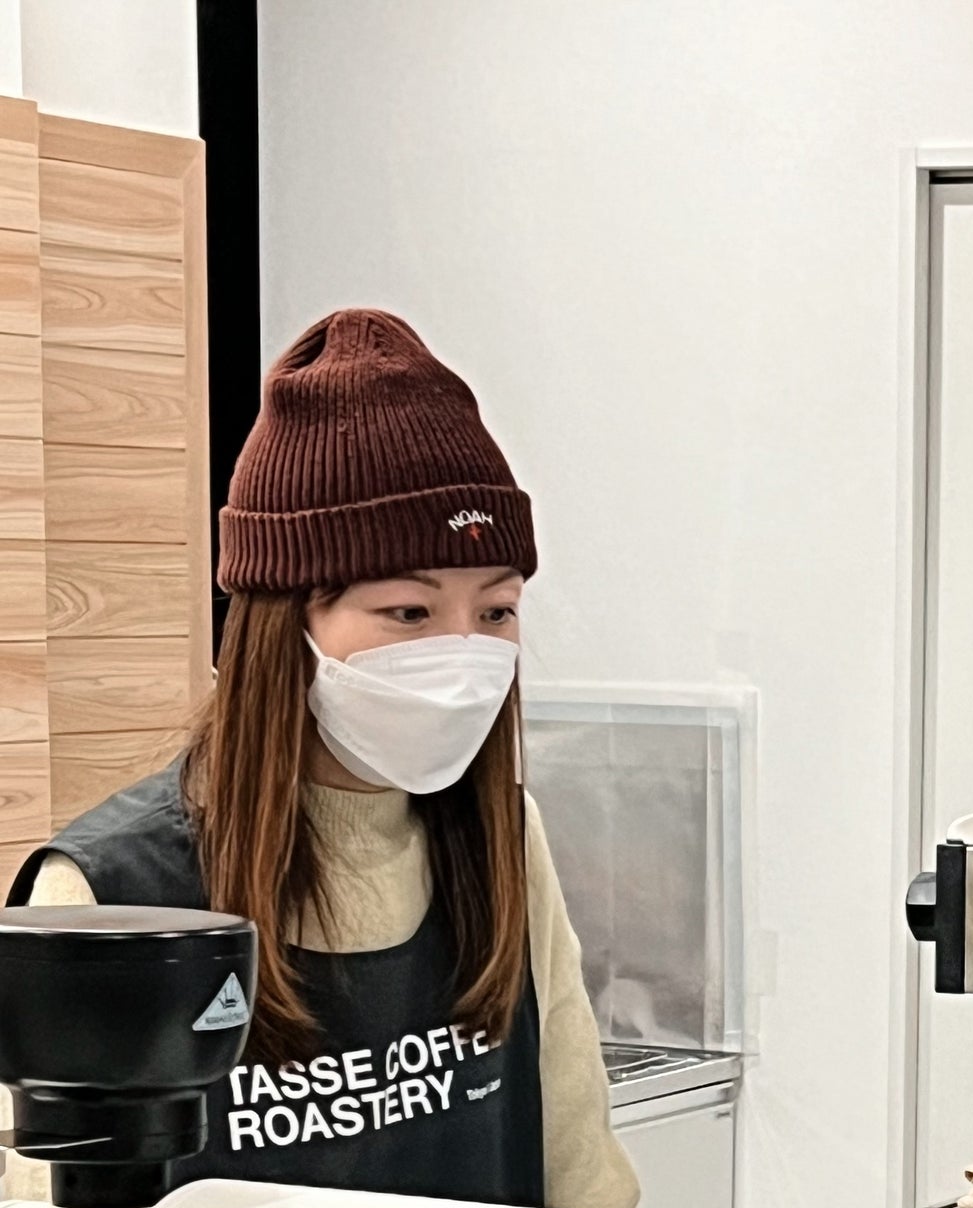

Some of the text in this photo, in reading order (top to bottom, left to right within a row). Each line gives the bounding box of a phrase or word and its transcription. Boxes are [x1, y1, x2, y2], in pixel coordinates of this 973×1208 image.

[228, 1023, 501, 1105] TASSE COFFE
[228, 1070, 454, 1150] ROASTERY
